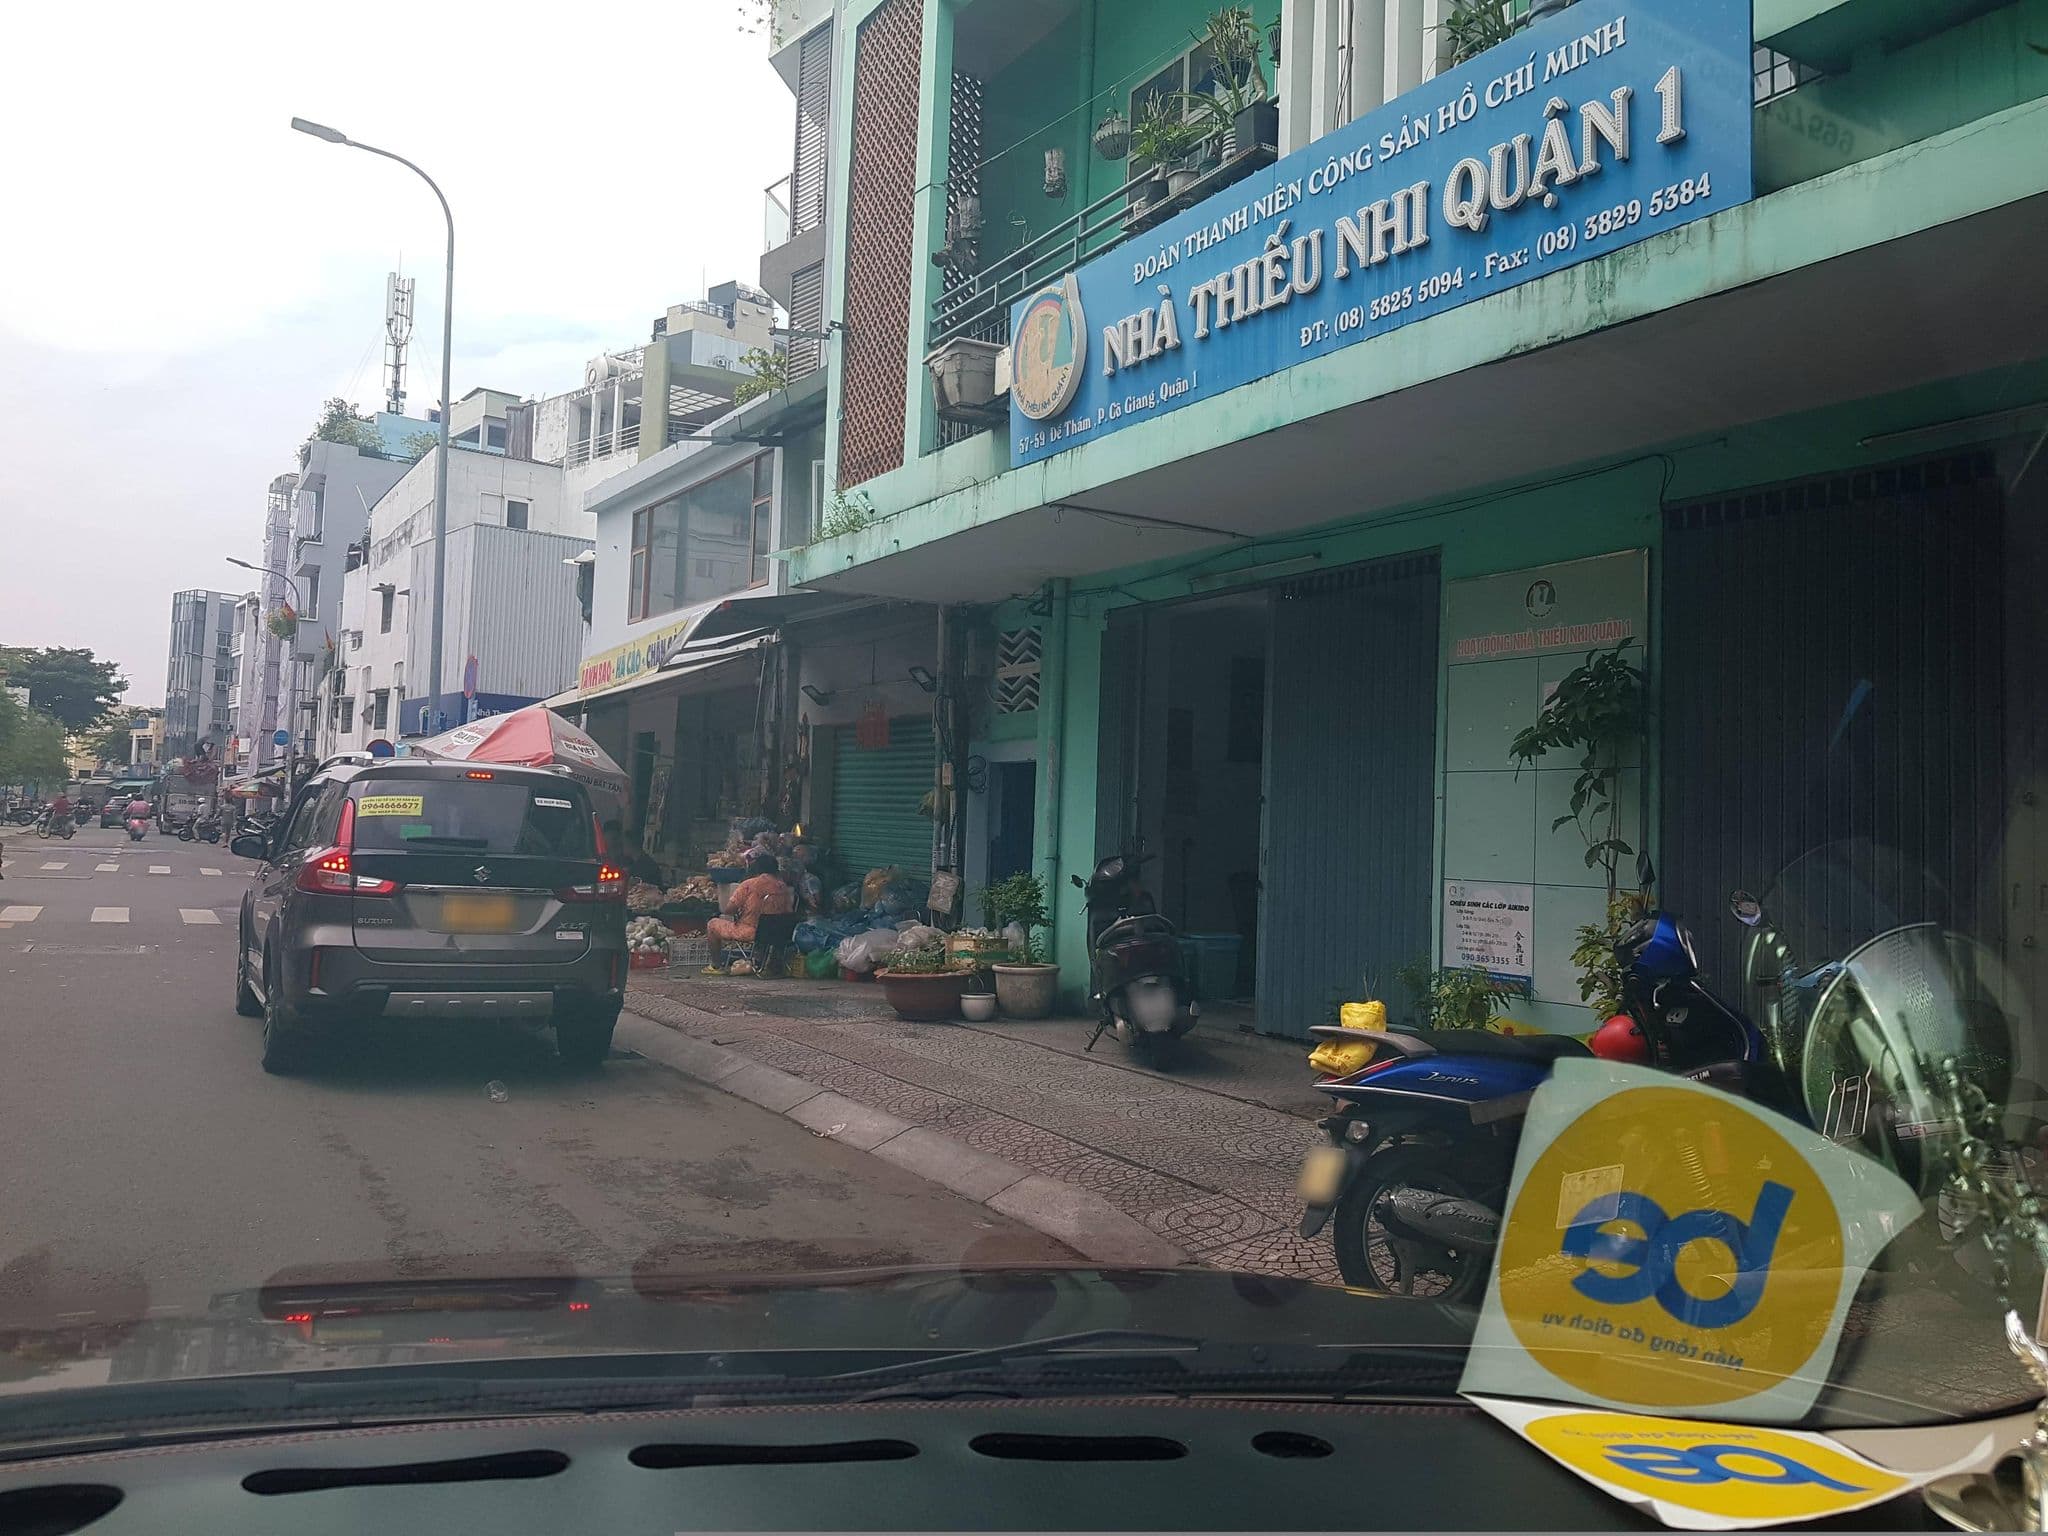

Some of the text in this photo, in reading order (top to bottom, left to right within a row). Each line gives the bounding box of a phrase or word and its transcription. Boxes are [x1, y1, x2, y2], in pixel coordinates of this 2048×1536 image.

[1134, 16, 1627, 285] ĐOÀN THANH NIÊN CỘNG SẢN HỒ CHÍ MINH
[1103, 65, 1687, 377] NHÀ THIẾU NHI QUẬN 1
[1300, 319, 1329, 348] ĐT:
[1334, 305, 1364, 336] (08)
[1369, 286, 1413, 321] 3823
[1417, 266, 1463, 302] 5094
[1484, 248, 1529, 278] Fax:
[1536, 222, 1577, 261] (08)
[1584, 199, 1642, 241] 3829
[1648, 172, 1712, 217] 5384
[1160, 377, 1189, 402] Quận
[1569, 624, 1591, 645] NHI
[1591, 618, 1622, 643] QUẬN
[1623, 619, 1632, 637] 1
[361, 802, 420, 810] 0964666677
[1482, 901, 1494, 909] CÁC
[1508, 904, 1529, 912] AIKIDO
[1461, 953, 1510, 965] 090 365 3355
[1419, 1071, 1480, 1085] Janus
